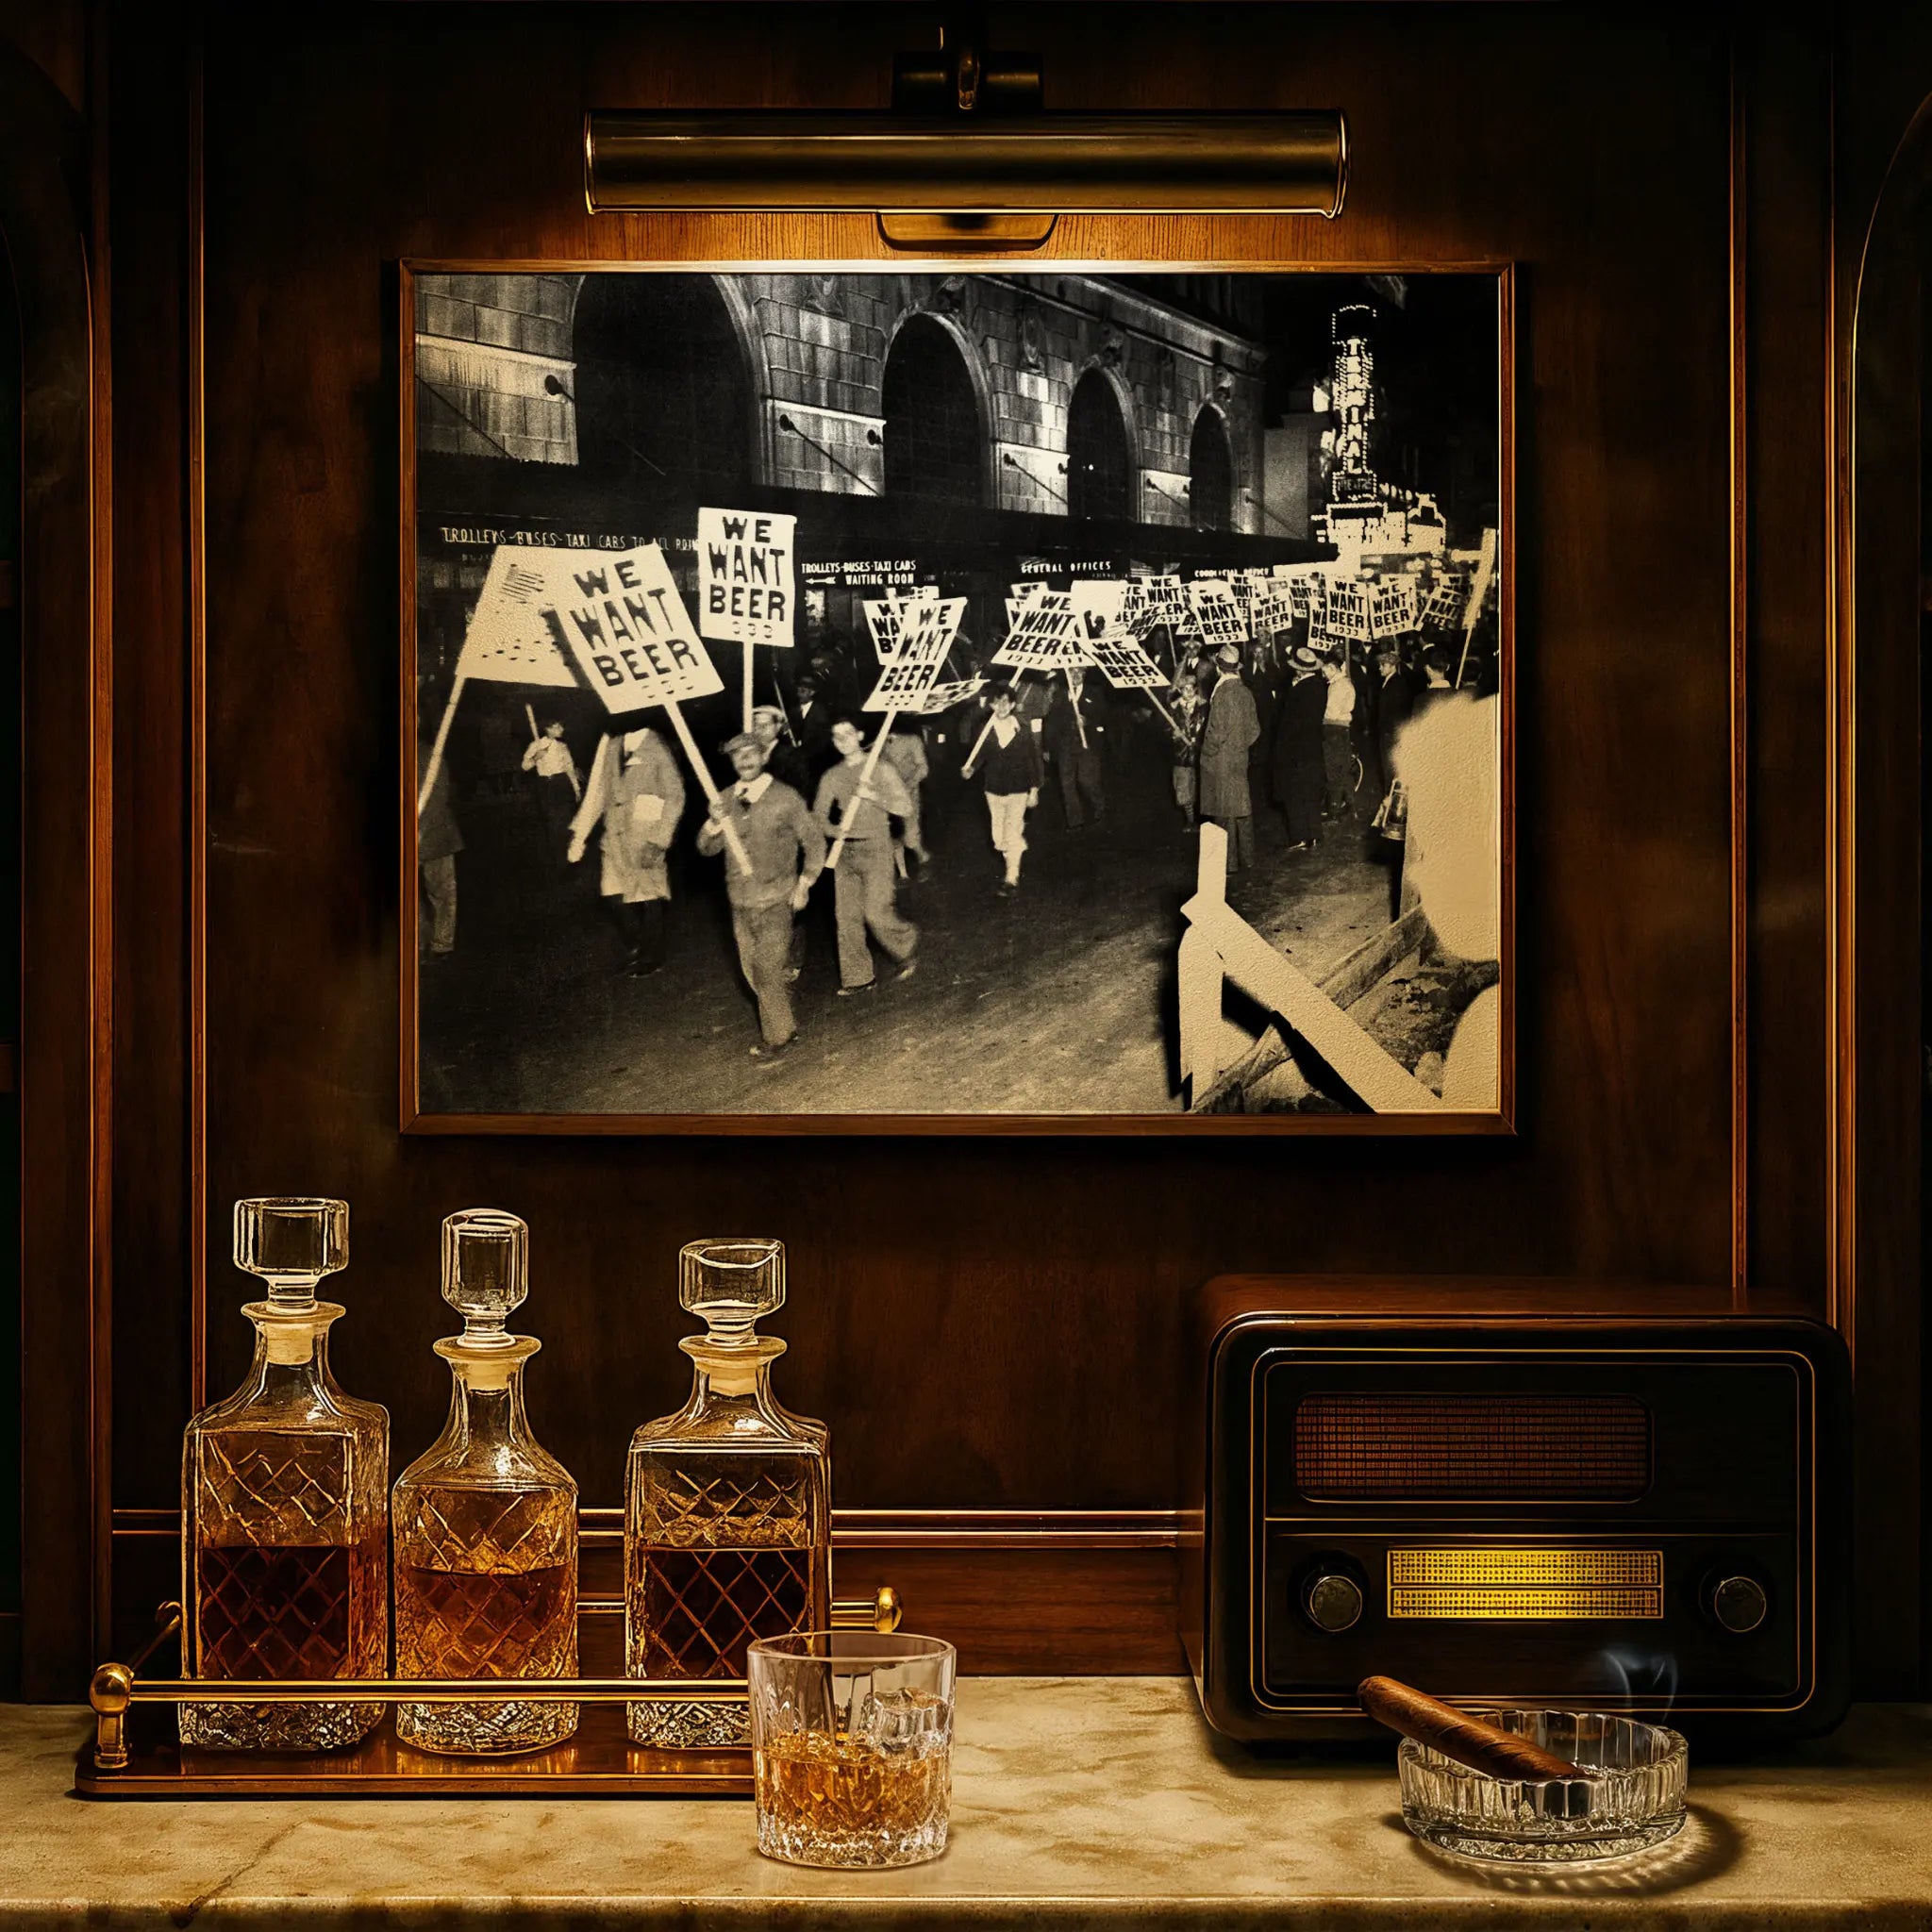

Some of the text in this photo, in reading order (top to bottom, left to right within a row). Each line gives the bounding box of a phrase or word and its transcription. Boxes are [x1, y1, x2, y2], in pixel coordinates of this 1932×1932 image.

[723, 516, 772, 543] WE
[599, 536, 625, 549] CABS
[708, 542, 785, 586] WANT
[894, 560, 916, 571] CABS
[1021, 561, 1111, 574] GENERAL OFFICES
[573, 559, 642, 598] WE
[845, 575, 883, 585] WAITING
[888, 574, 914, 584] ROOM
[1151, 577, 1173, 587] WE
[1231, 584, 1253, 598] WANT
[1335, 580, 1358, 593] WE
[1378, 583, 1400, 596] WE
[709, 584, 786, 622] BEER
[1041, 595, 1071, 610] WE
[1124, 595, 1145, 610] ANT
[1147, 588, 1179, 603] WANT
[1200, 593, 1226, 605] WE
[1259, 595, 1280, 606] WE
[1329, 591, 1364, 612] WANT
[1373, 592, 1407, 613] WANT
[919, 604, 951, 626] WE
[1197, 604, 1237, 622] WANT
[1255, 600, 1287, 620] WANT
[569, 588, 674, 651] WANT
[1019, 611, 1075, 636] WANT
[1329, 609, 1364, 628] BEER
[1374, 609, 1409, 628] BEER
[1202, 620, 1242, 635] BEER
[1335, 626, 1358, 636] 1933
[1005, 634, 1061, 655] BEER
[1092, 641, 1126, 651] WE
[592, 639, 699, 687] BEER
[1092, 650, 1145, 665] WANT
[880, 664, 935, 691] BEER
[1105, 665, 1158, 677] BEER
